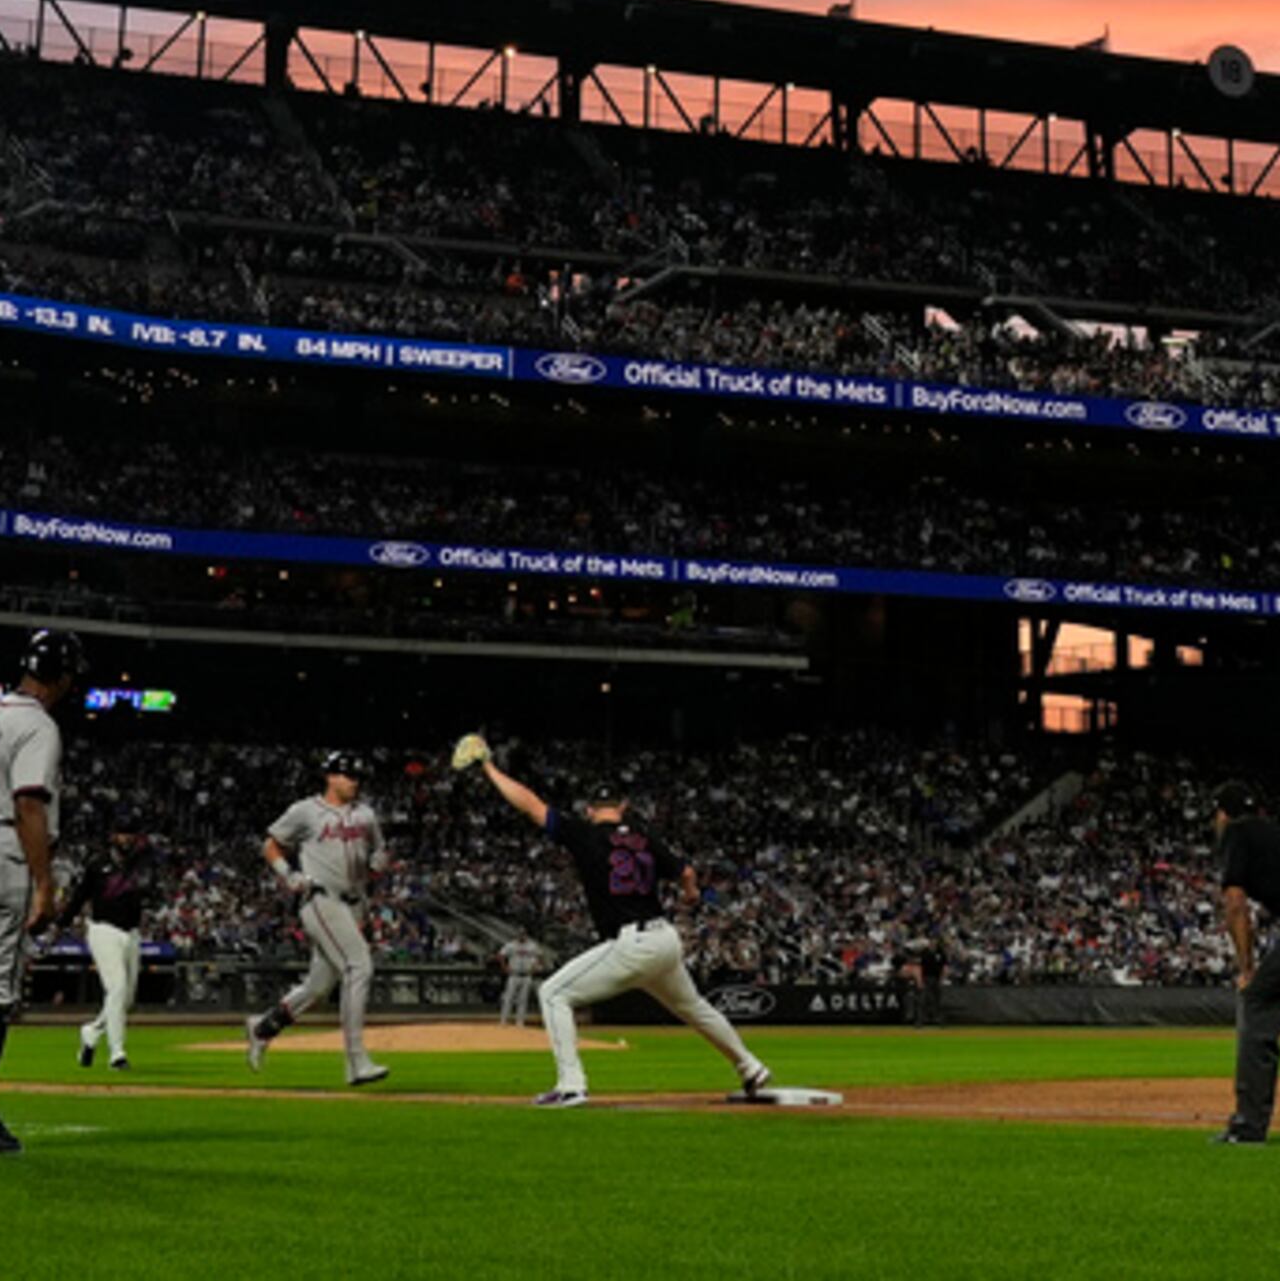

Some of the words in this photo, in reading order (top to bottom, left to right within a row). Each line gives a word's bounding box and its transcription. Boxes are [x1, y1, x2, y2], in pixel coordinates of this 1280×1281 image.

[1220, 59, 1240, 84] 18
[297, 338, 327, 355] 84
[331, 341, 380, 360] MPH
[400, 346, 502, 369] SWEEPER
[625, 363, 700, 388] Official
[706, 369, 764, 393] Truck
[768, 375, 791, 395] of
[796, 377, 831, 399] the
[836, 381, 886, 403] Mets
[913, 384, 1086, 418] BuyFordNow.com
[1203, 410, 1269, 433] Official
[14, 515, 171, 548] BuyFordNow.com
[440, 548, 504, 568] Official
[509, 552, 558, 571] Truck
[562, 556, 583, 572] of
[587, 558, 617, 574] the
[621, 560, 664, 577] Mets
[686, 562, 837, 586] BuyFordNow.com
[1064, 584, 1120, 602] Official
[1124, 587, 1167, 605] Truck
[1166, 591, 1188, 606] of
[1186, 593, 1216, 608] the
[1219, 594, 1256, 610] Mets
[830, 993, 899, 1010] DELTA
